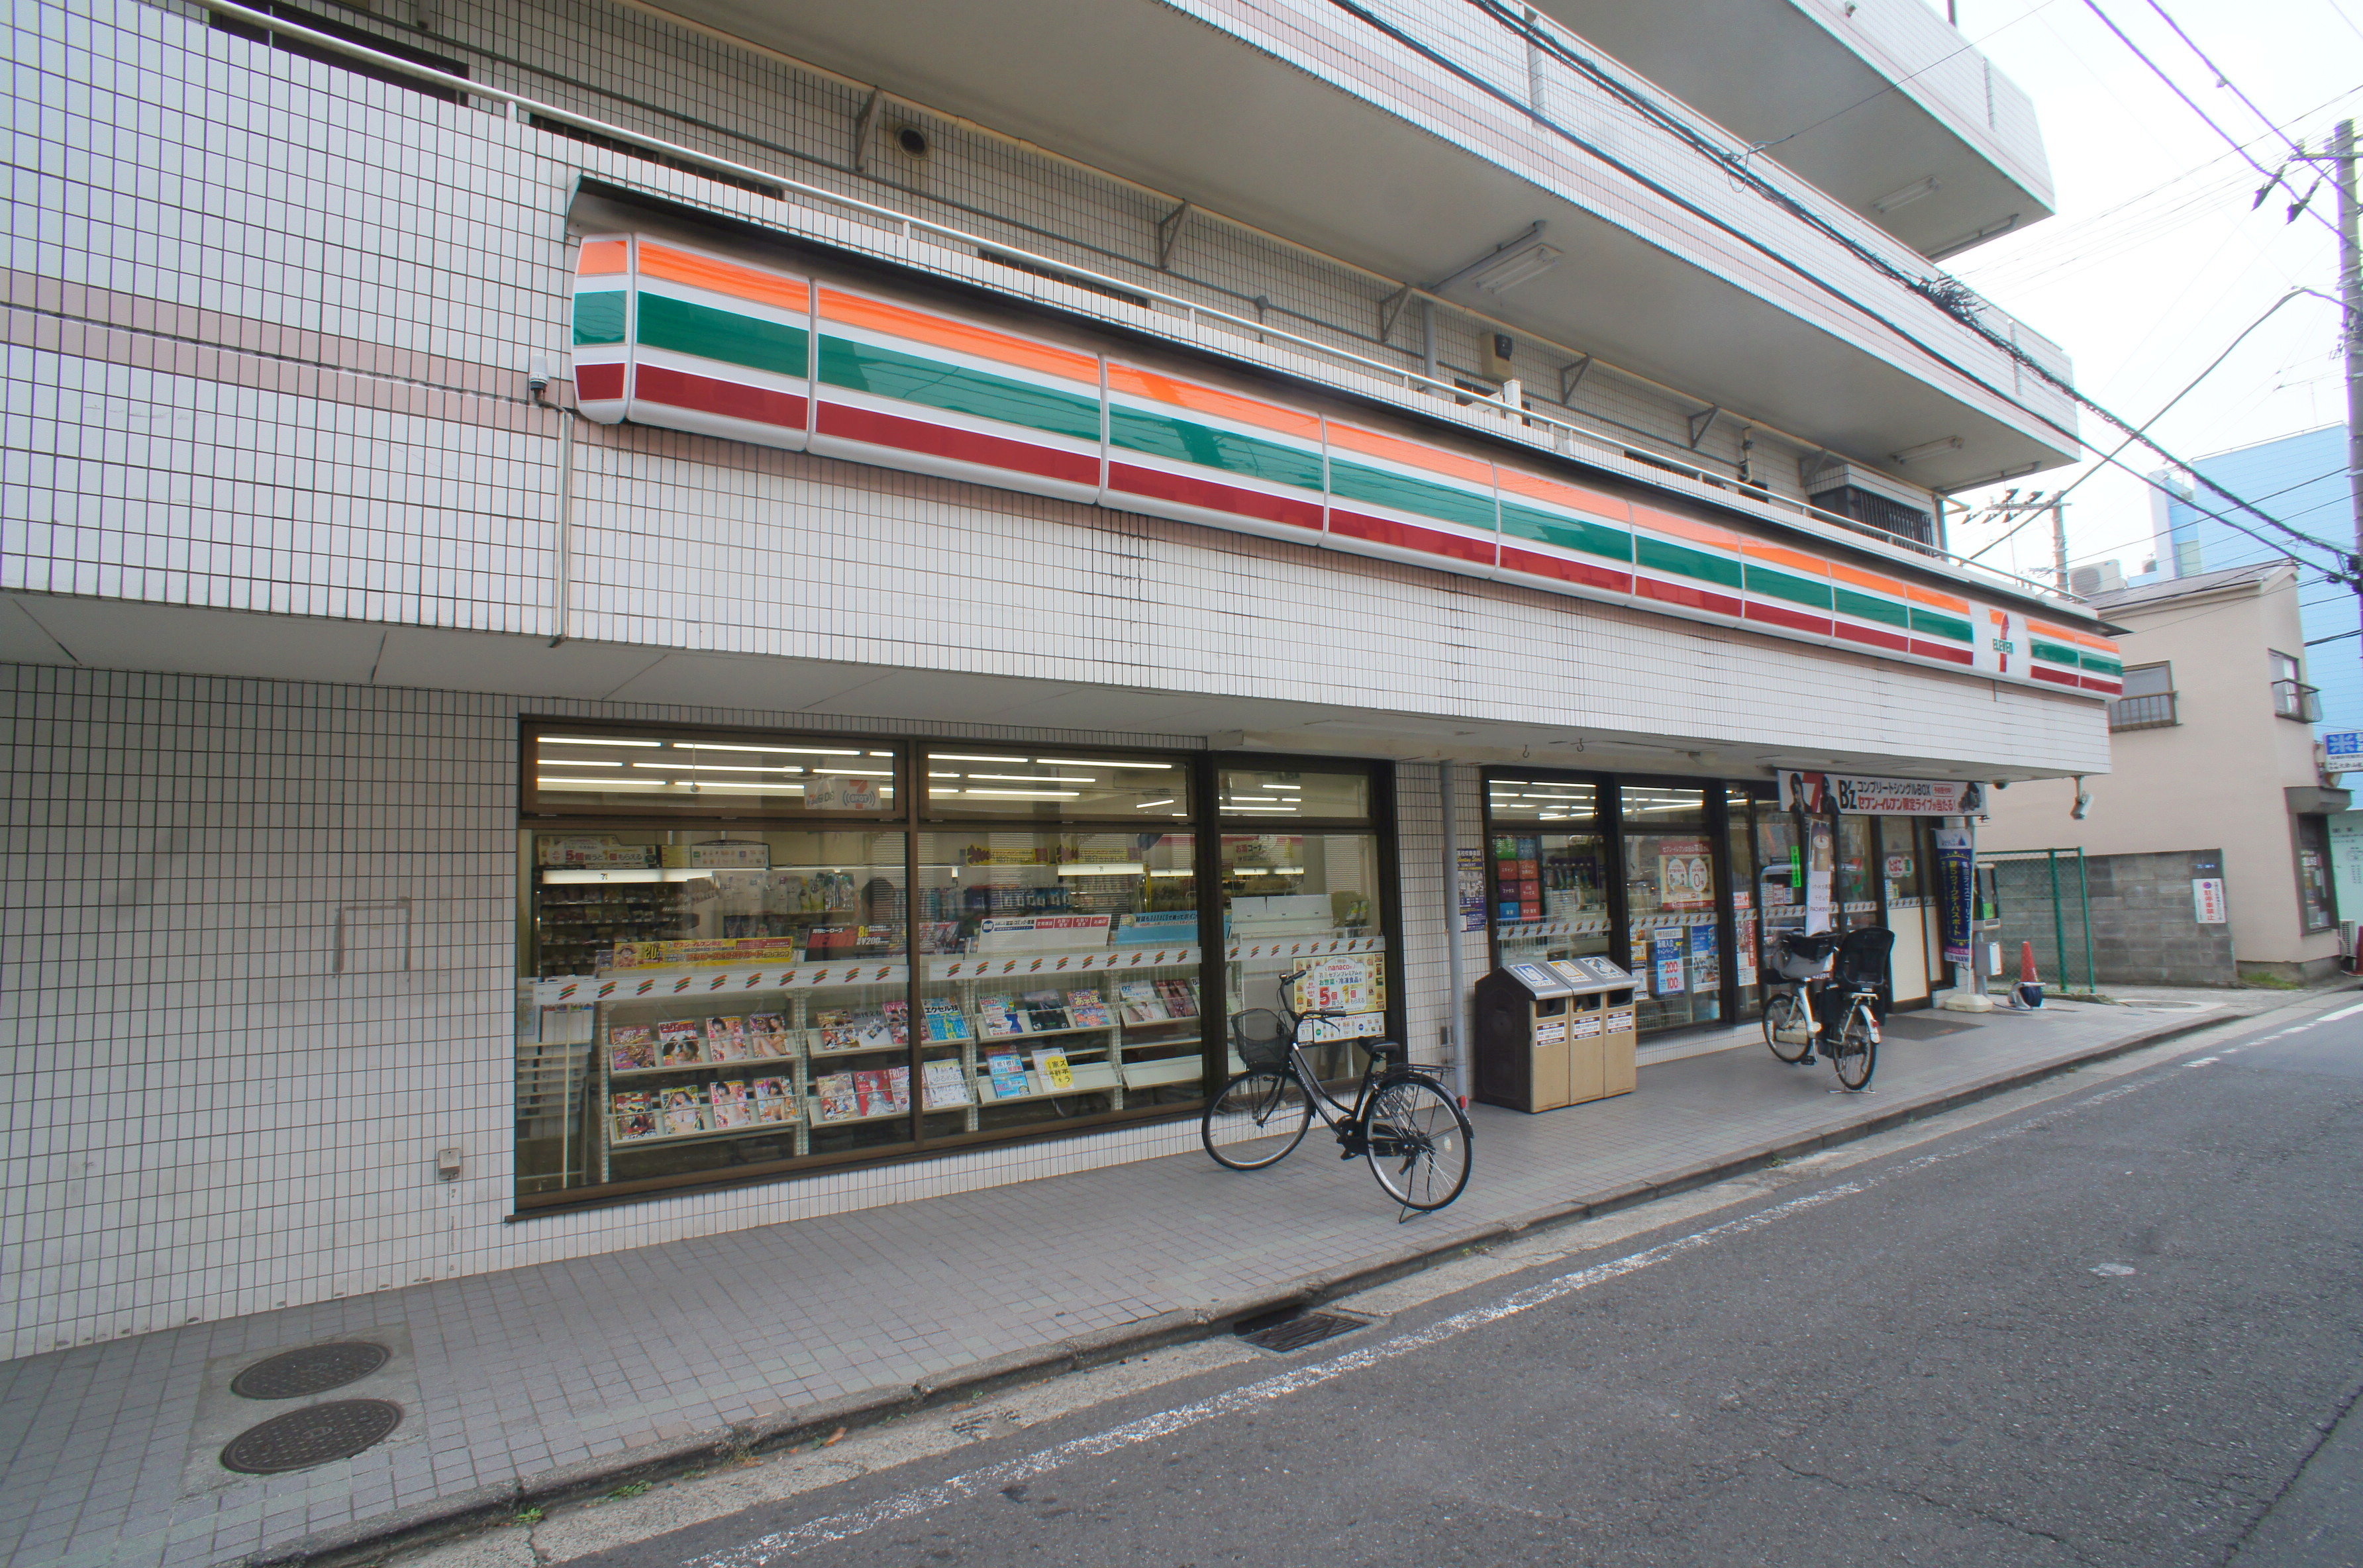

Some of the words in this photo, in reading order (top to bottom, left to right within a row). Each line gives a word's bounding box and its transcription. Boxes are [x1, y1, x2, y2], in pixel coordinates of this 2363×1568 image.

[1993, 638, 2014, 654] ELEVEN
[1664, 961, 1678, 973] 200
[1666, 977, 1678, 989] 100
